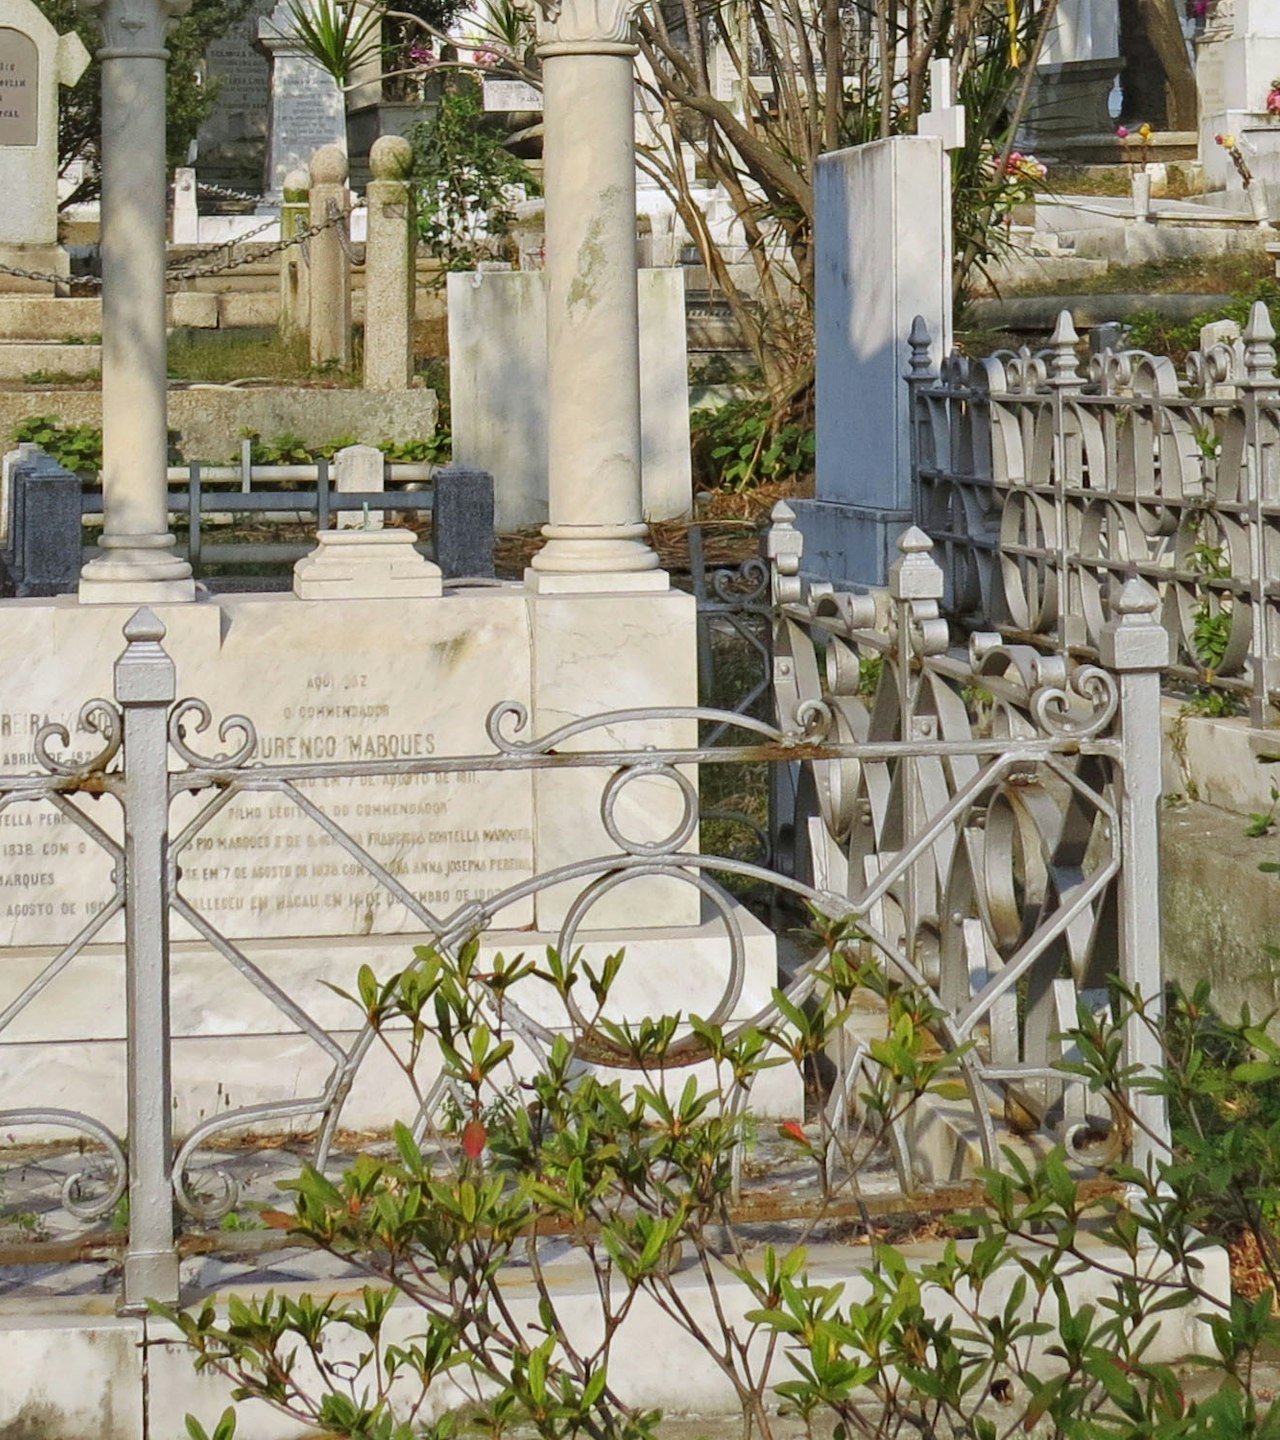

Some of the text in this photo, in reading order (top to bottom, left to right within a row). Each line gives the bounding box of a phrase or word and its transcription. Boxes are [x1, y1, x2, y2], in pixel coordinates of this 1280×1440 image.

[299, 704, 390, 719] COMMENDADOR
[356, 801, 449, 817] COMMENDADOR
[42, 840, 69, 855] COM
[203, 867, 219, 881] EM
[224, 867, 231, 880] 7
[234, 865, 248, 879] DE
[5, 902, 53, 917] AGOSTO
[61, 901, 77, 915] DE
